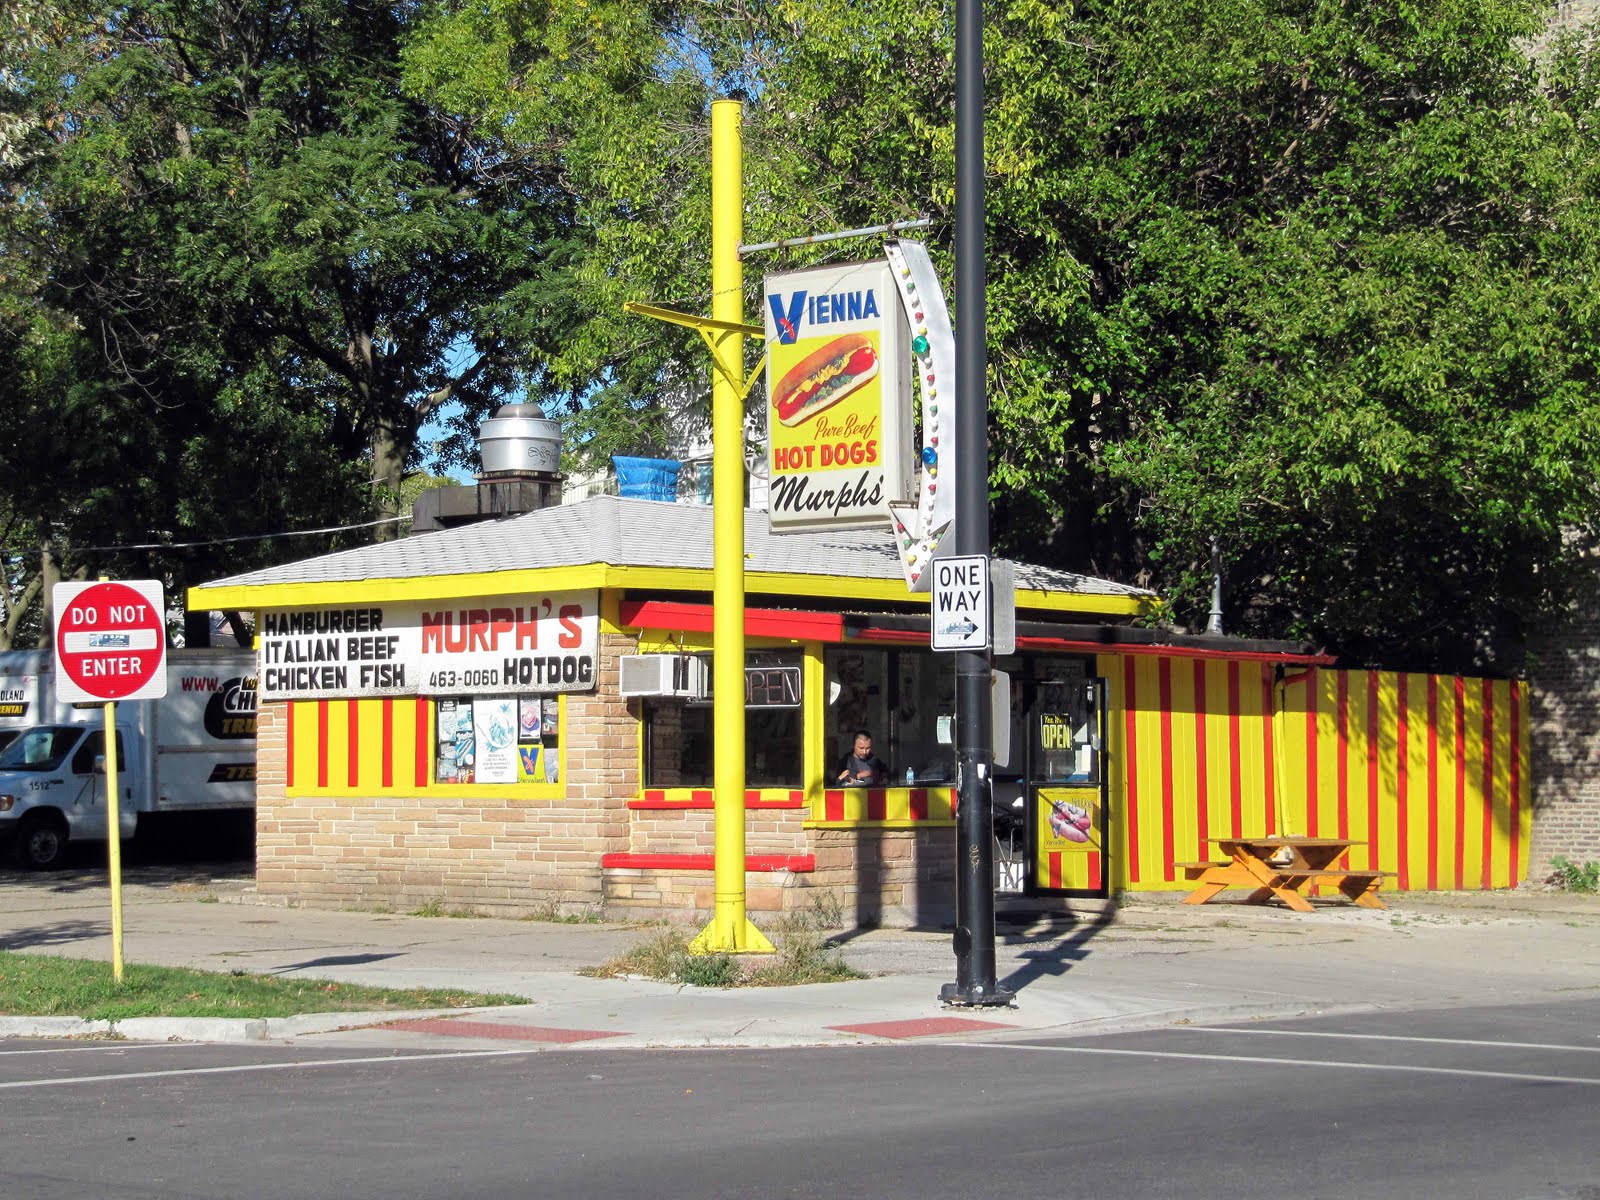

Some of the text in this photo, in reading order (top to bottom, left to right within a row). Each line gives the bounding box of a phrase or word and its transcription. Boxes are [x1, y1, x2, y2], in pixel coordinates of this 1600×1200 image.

[768, 289, 880, 345] VIENNA
[814, 413, 877, 440] Pure Beef
[775, 440, 877, 470] HOT DOGS
[940, 565, 980, 587] ONE
[939, 590, 981, 612] WAY
[72, 605, 146, 625] DO NOT
[265, 608, 383, 636] HAMBURGER
[422, 598, 583, 654] MURPH'S
[265, 635, 400, 664] ITALIAN BEEF
[82, 657, 142, 677] ENTER
[265, 665, 348, 691] CHICKEN
[360, 663, 406, 688] FISH
[429, 669, 499, 687] 463-0060
[503, 655, 593, 685] HOTDOG
[745, 671, 798, 703] PEN
[1042, 724, 1070, 749] OPEN
[30, 781, 50, 790] 1512
